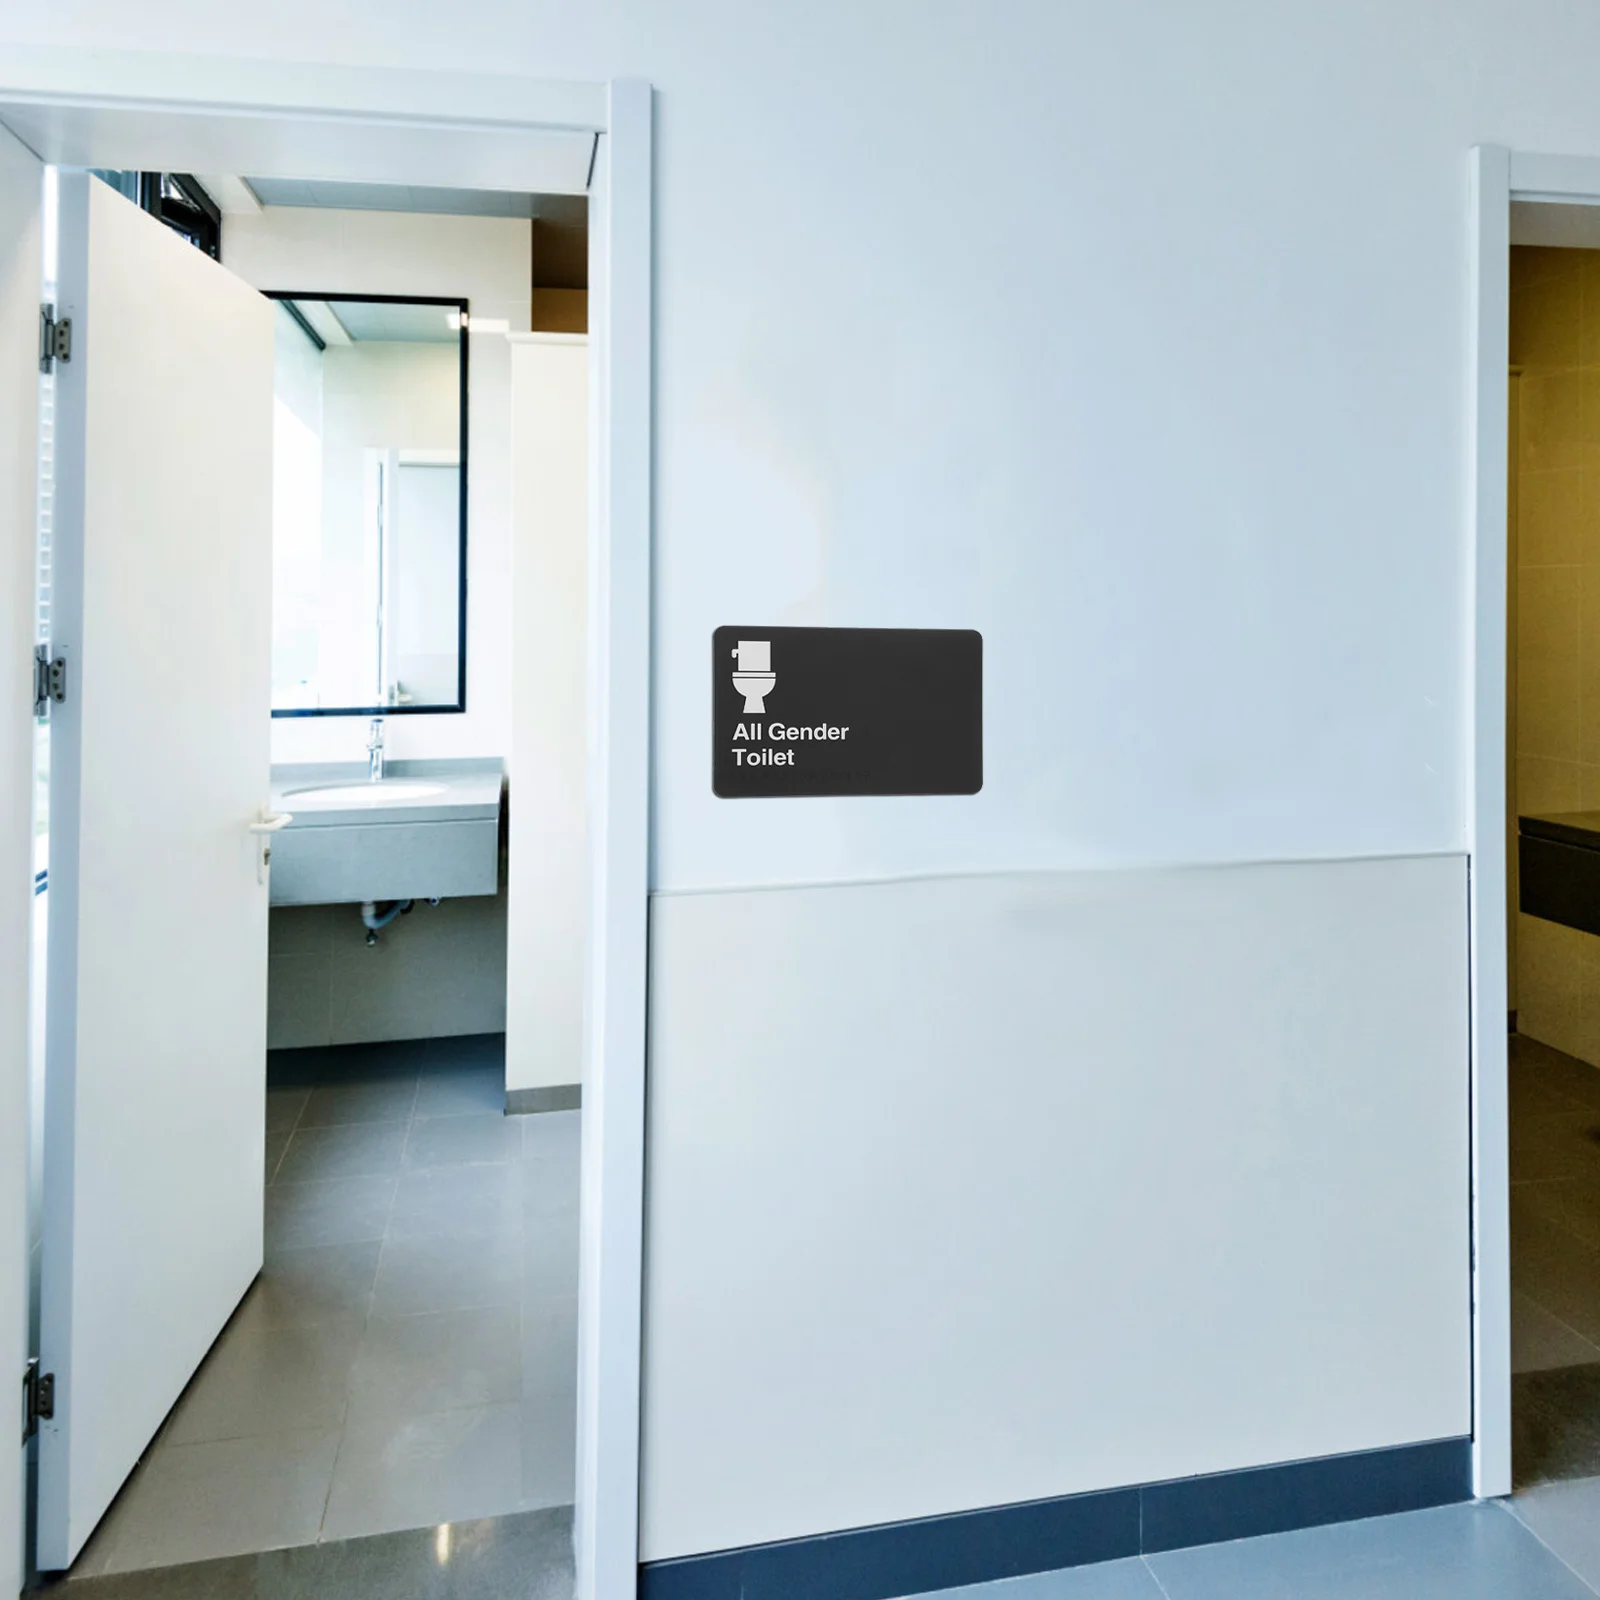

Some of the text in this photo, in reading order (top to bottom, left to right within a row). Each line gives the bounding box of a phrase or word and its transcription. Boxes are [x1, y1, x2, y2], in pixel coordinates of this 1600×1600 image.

[732, 722, 850, 741] All Gender
[731, 748, 795, 767] Toilet
